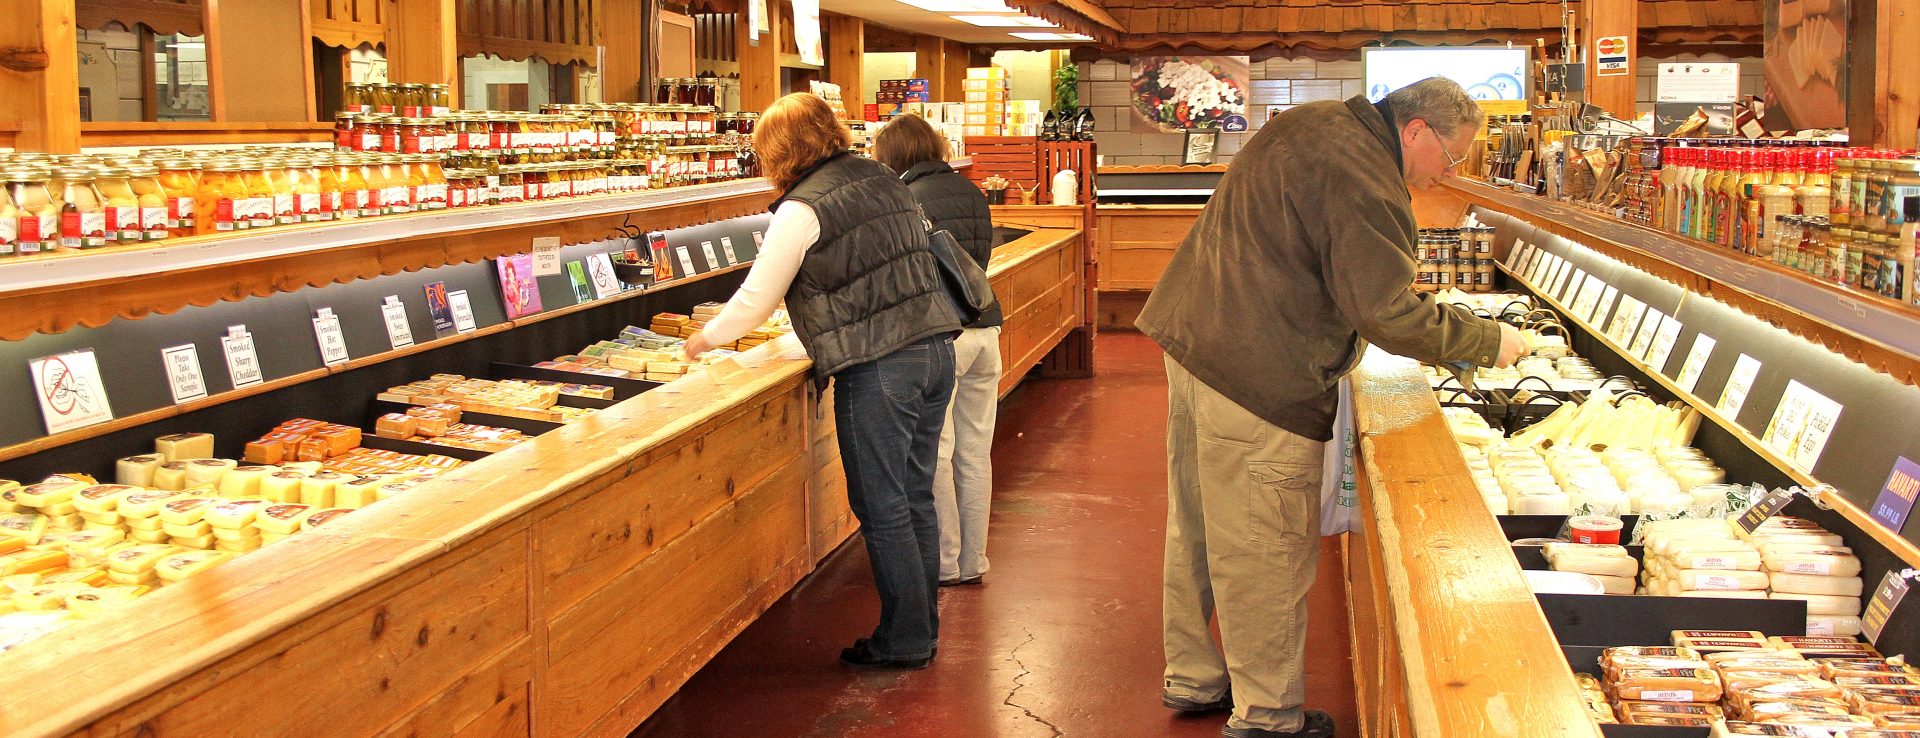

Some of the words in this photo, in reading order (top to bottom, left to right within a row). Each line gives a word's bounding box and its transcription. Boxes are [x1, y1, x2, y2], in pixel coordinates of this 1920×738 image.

[319, 323, 338, 334] Smoked
[326, 335, 336, 344] Hot
[229, 341, 251, 353] Smoked
[326, 346, 342, 357] Pepper
[174, 354, 189, 364] Please
[235, 357, 251, 367] Sharp
[177, 363, 190, 373] Take
[175, 373, 187, 384] Only
[187, 372, 198, 381] One
[235, 369, 258, 381] Cheddar
[181, 382, 198, 393] Sample
[1810, 412, 1831, 433] Pickled
[1886, 469, 1920, 503] HAVARTI
